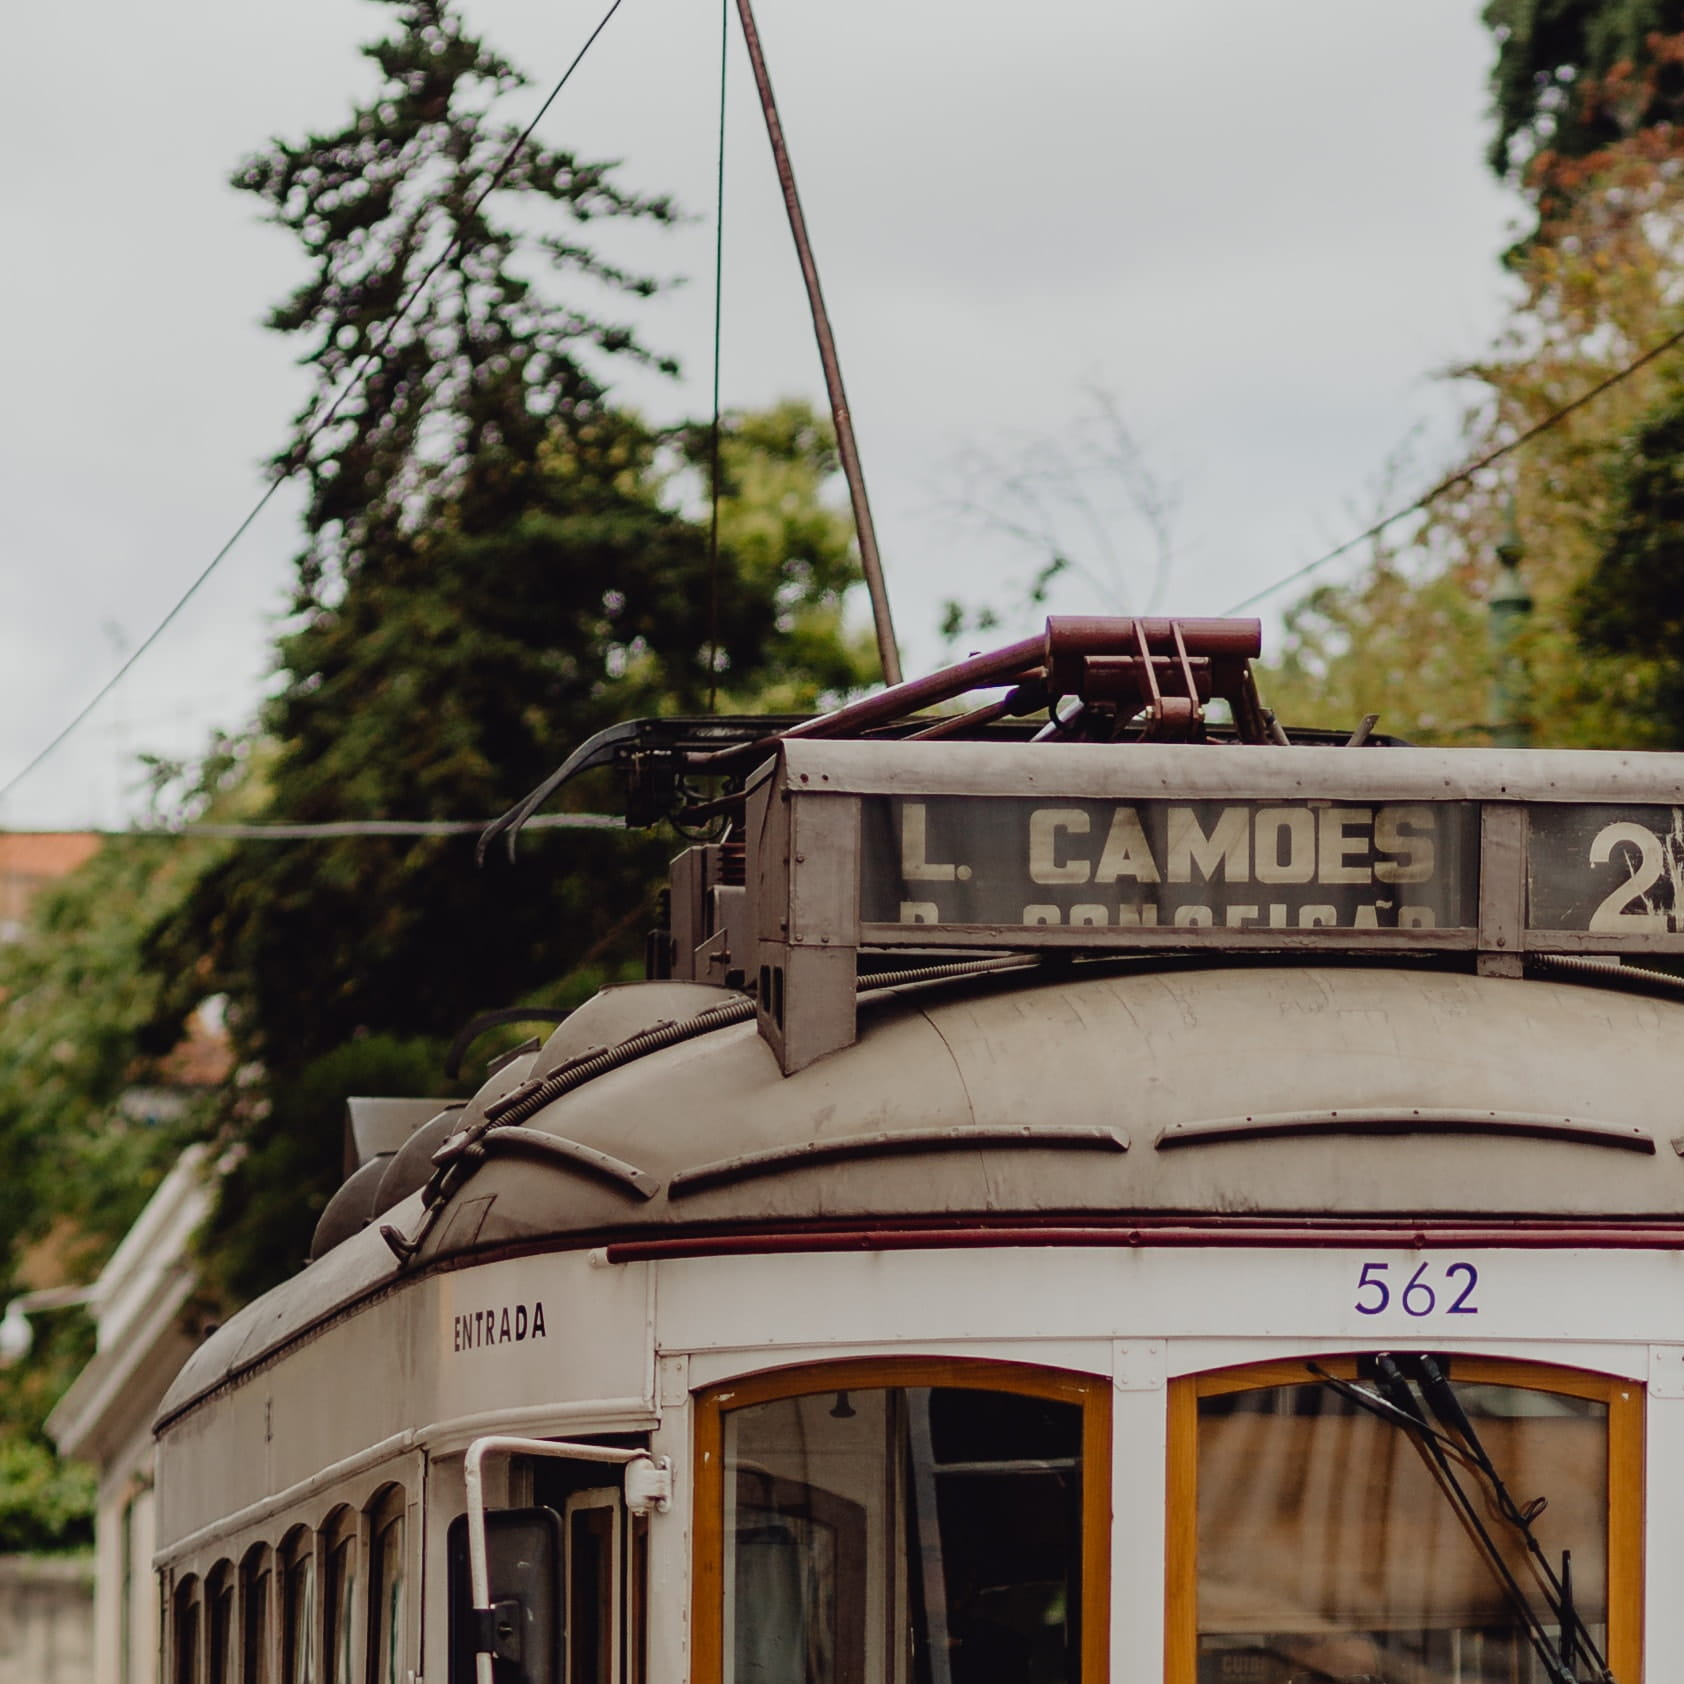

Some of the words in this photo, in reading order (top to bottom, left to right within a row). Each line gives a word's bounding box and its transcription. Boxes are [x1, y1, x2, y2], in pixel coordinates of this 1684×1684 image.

[901, 803, 973, 881] L.
[1354, 1261, 1479, 1317] 562
[454, 1302, 546, 1352] ENTRADA
